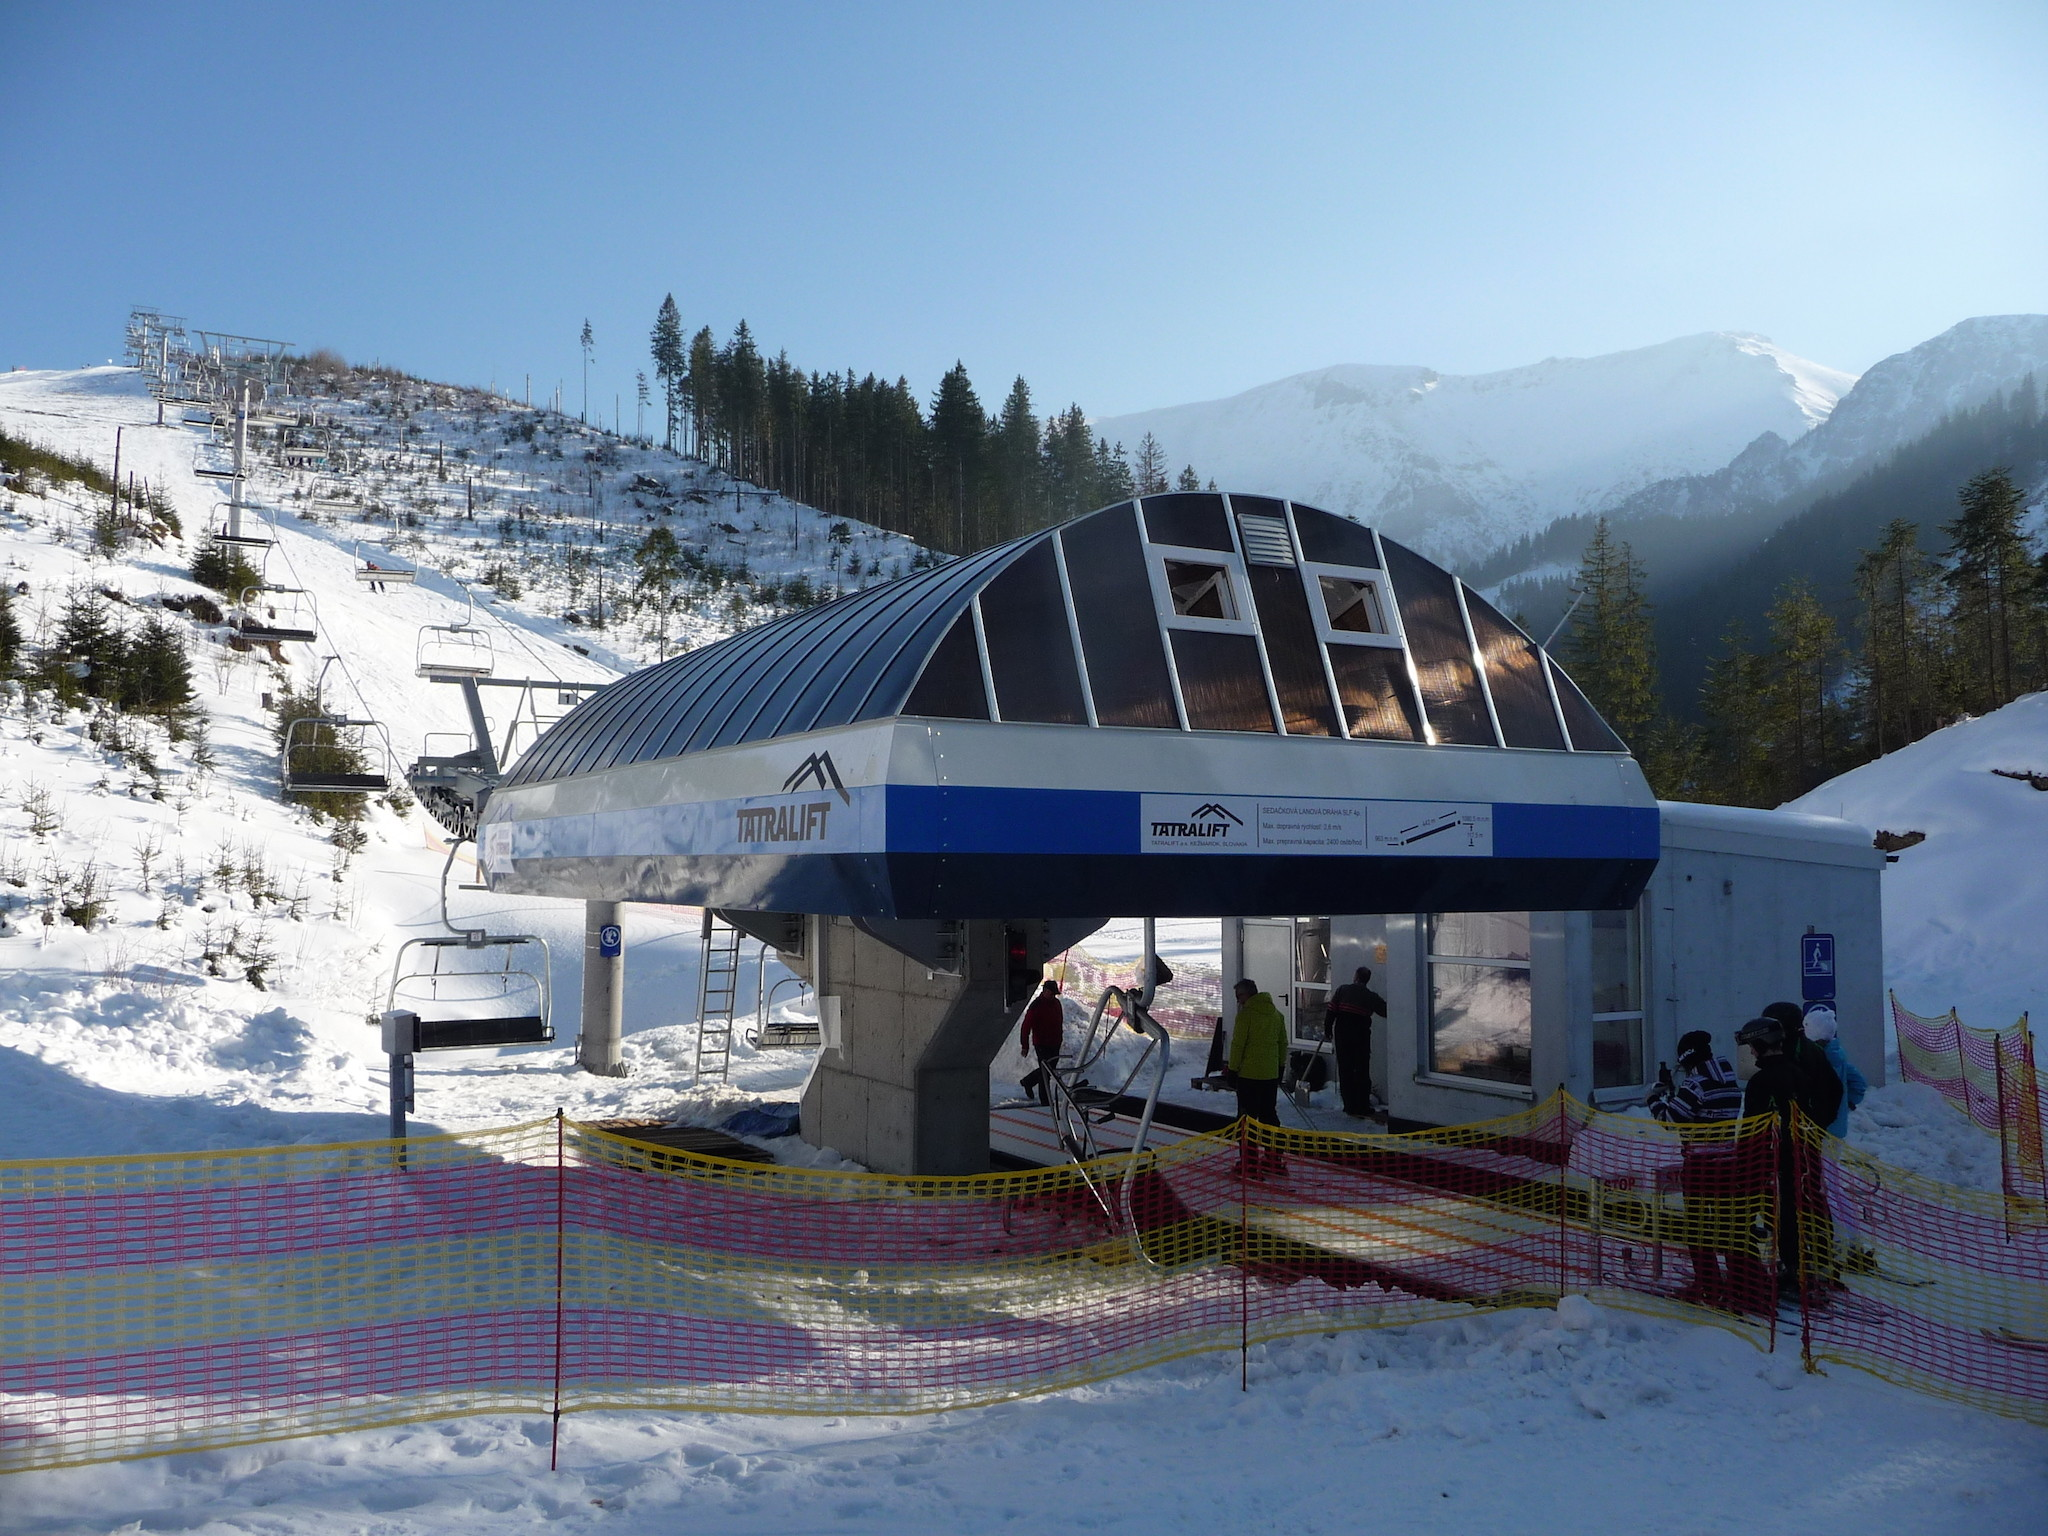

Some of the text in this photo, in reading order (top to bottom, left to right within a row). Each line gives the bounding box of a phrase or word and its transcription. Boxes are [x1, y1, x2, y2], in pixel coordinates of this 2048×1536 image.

[565, 694, 570, 704] 1
[737, 802, 831, 843] TATRALIFT
[1151, 822, 1230, 837] TATRALIFT
